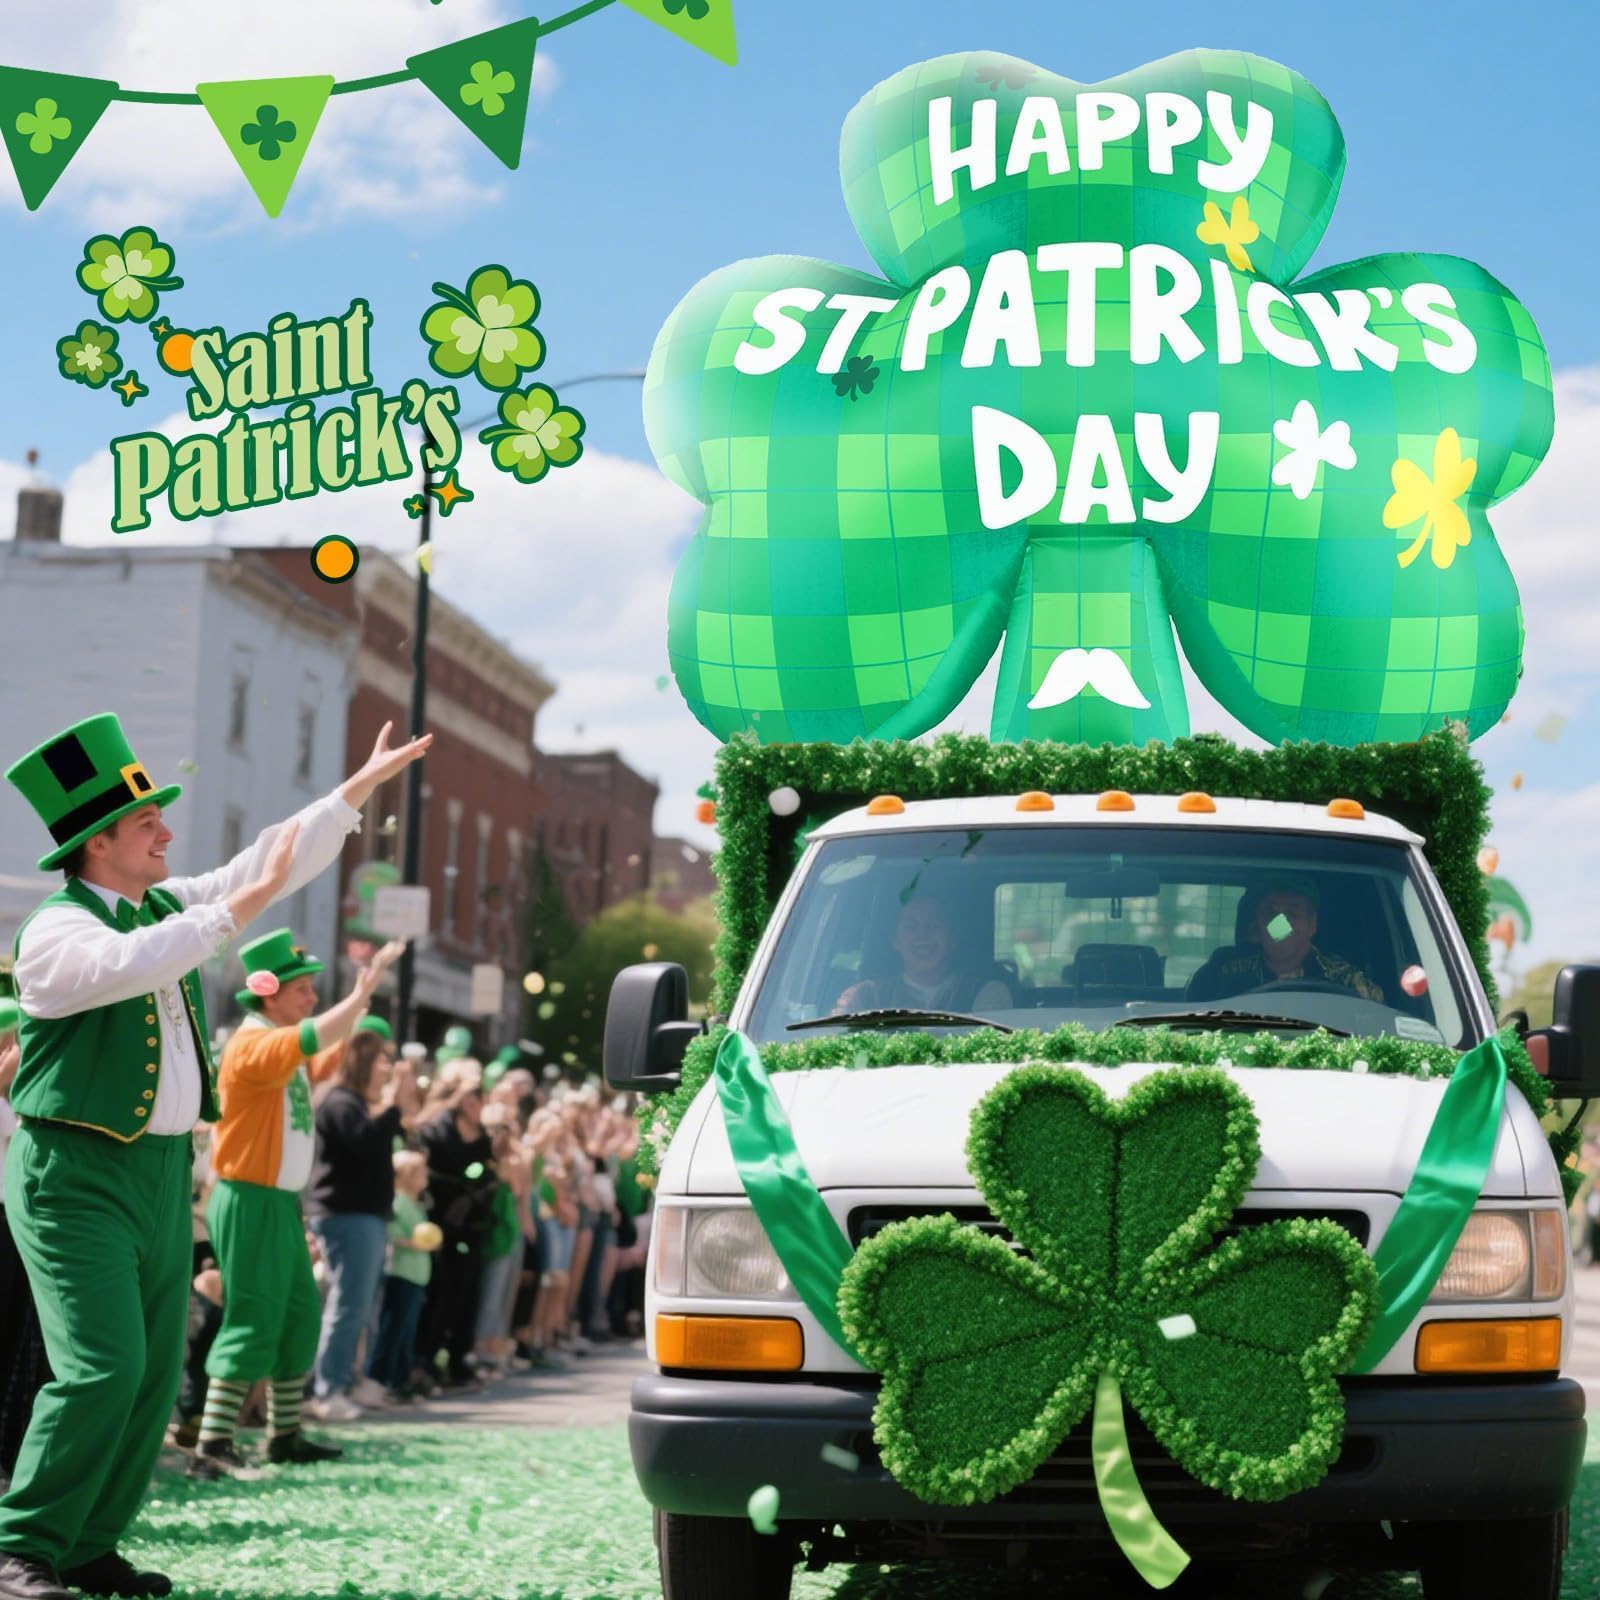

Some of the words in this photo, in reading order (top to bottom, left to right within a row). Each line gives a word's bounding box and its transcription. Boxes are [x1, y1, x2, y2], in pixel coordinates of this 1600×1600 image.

[928, 90, 1275, 206] HAPPY
[733, 287, 900, 376] ST
[899, 241, 1478, 375] PATRICK'S
[970, 404, 1221, 530] DAY
